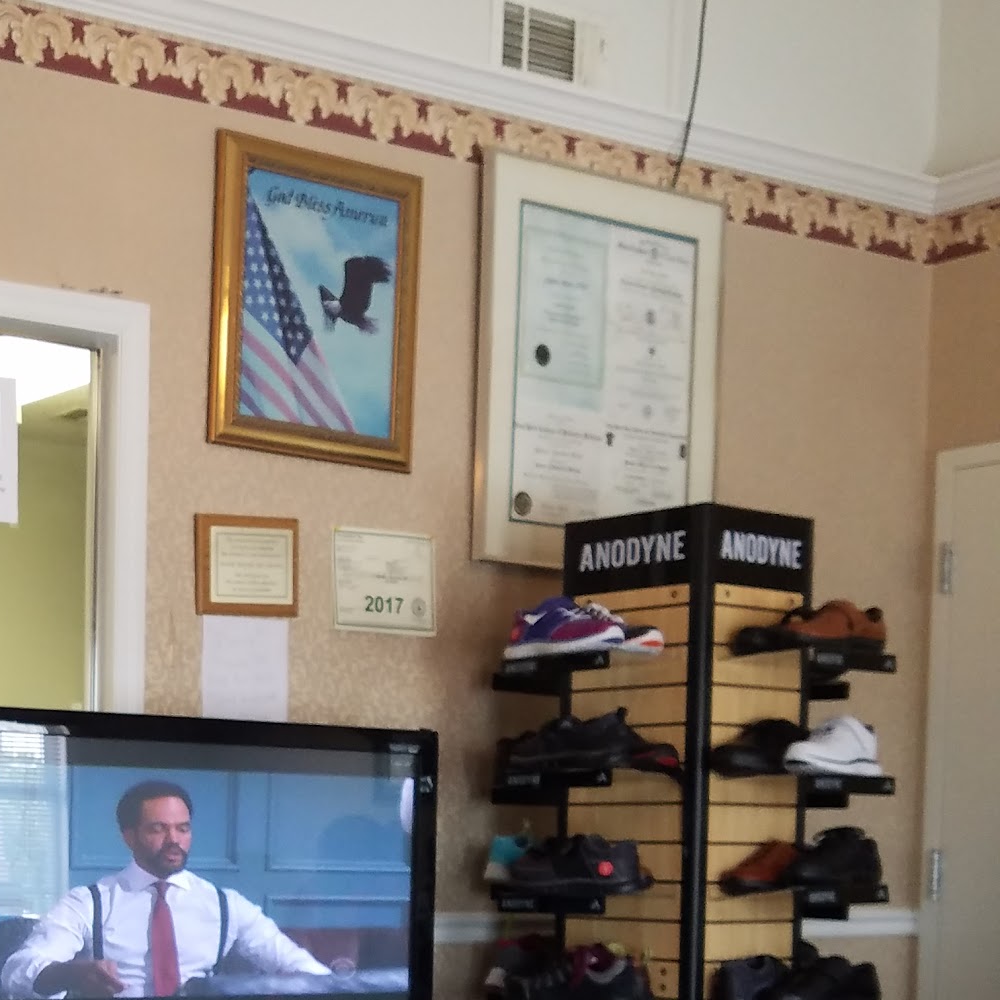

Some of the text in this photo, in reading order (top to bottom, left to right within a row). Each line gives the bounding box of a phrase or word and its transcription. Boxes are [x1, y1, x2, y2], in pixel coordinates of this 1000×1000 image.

[265, 185, 295, 207] God
[333, 200, 389, 226] America
[579, 529, 687, 573] ANODYNE
[720, 529, 802, 570] ANODYNE
[365, 595, 404, 614] 2017
